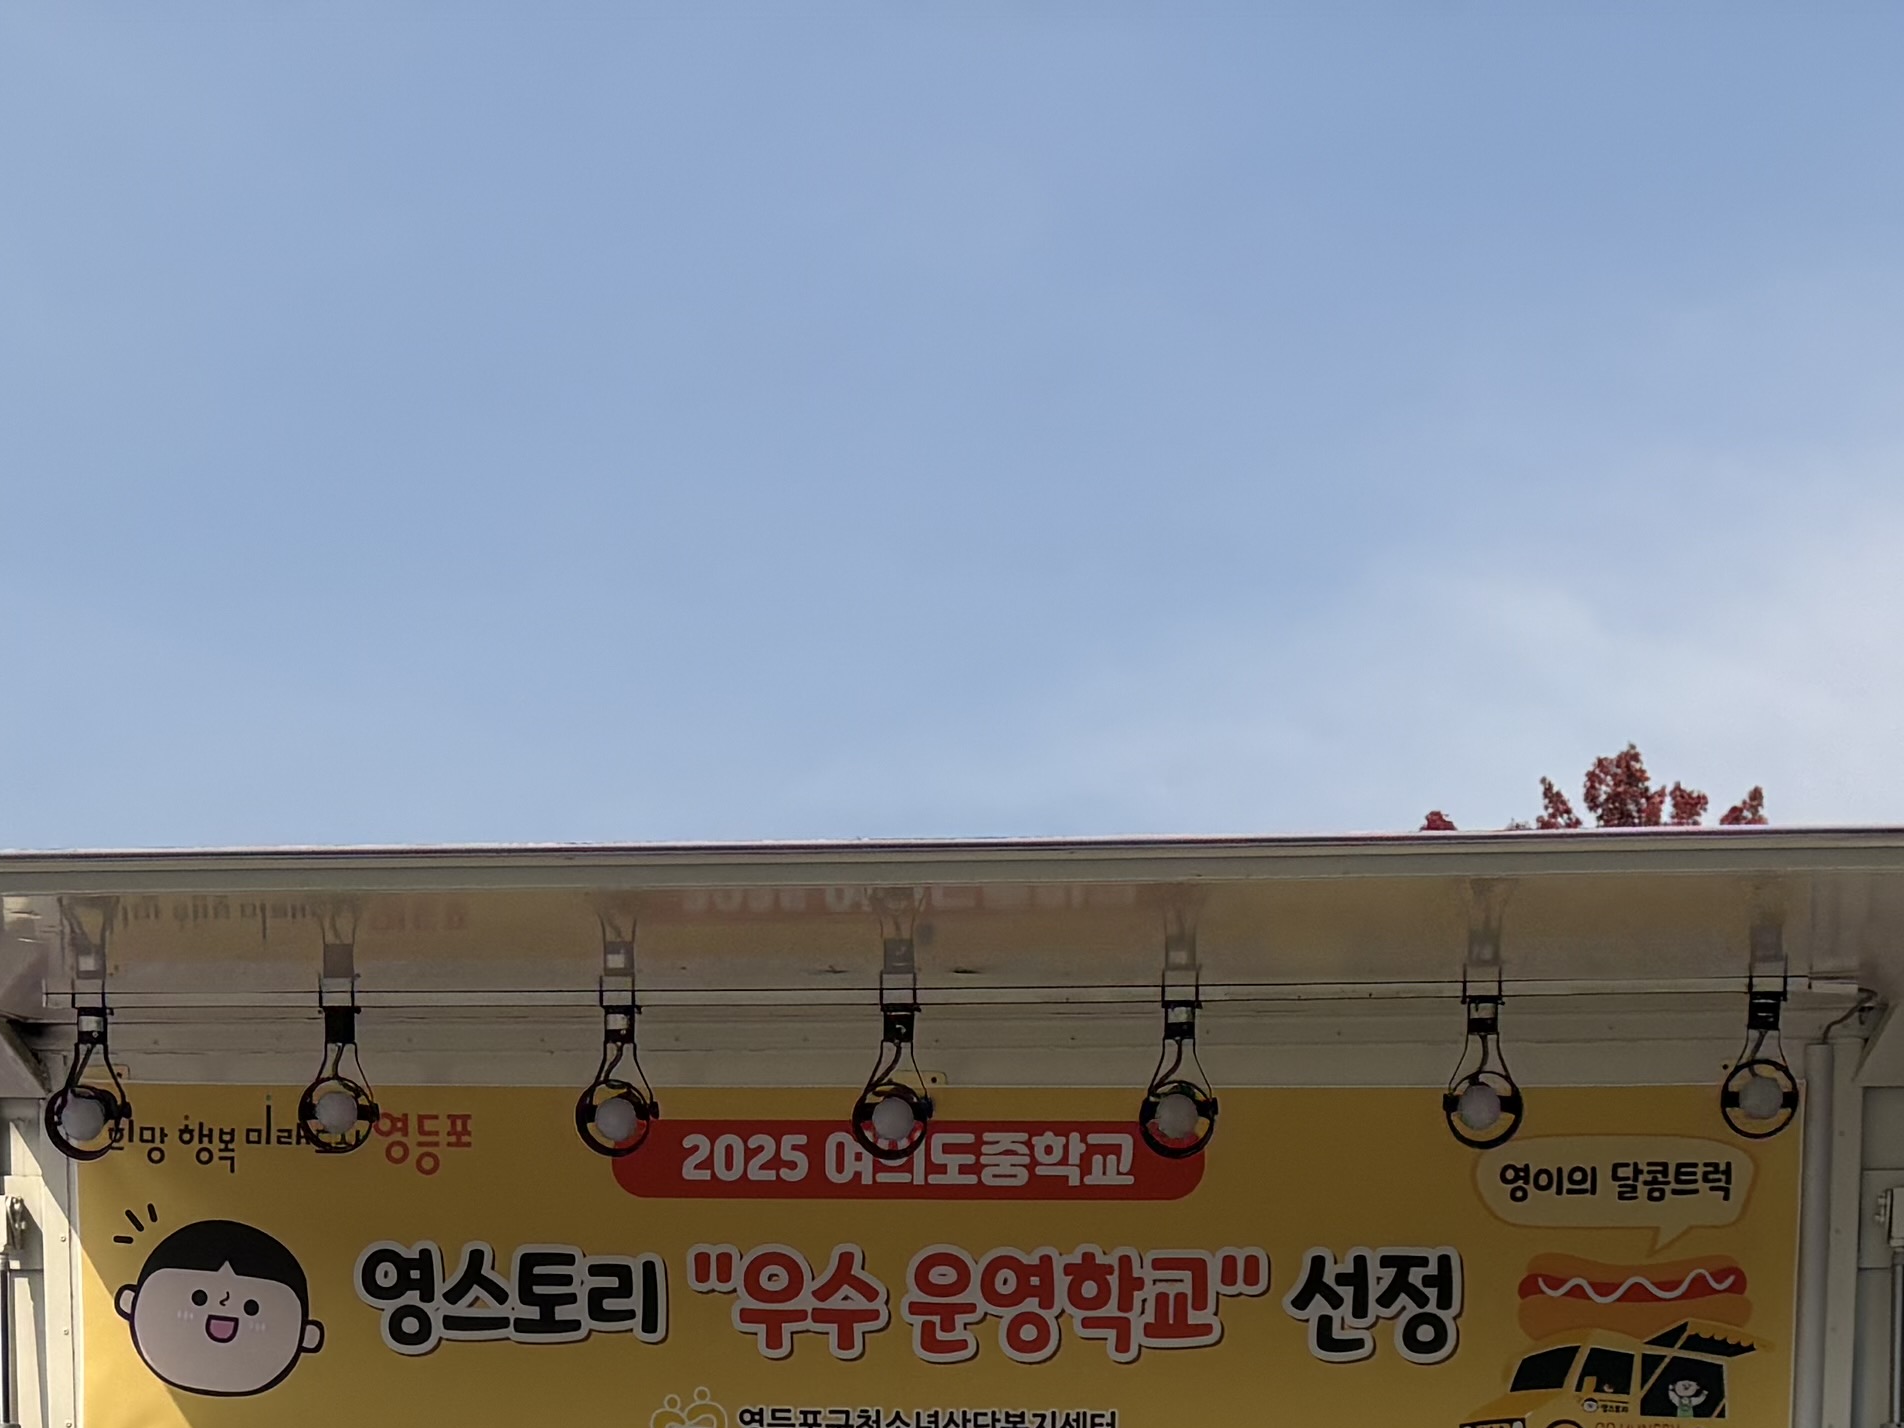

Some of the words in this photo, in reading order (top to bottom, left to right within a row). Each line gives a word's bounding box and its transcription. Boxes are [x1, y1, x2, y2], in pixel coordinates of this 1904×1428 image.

[108, 1117, 169, 1166] 희망
[177, 1114, 237, 1174] 행복
[372, 1111, 473, 1176] 영등포
[681, 1133, 810, 1183] 2025
[824, 1130, 1136, 1188] 여의도중학교
[1498, 1162, 1598, 1200] 영이의
[1610, 1161, 1734, 1201] 달콤트럭
[360, 1246, 662, 1347] 영스토리
[1291, 1250, 1459, 1360] 선정
